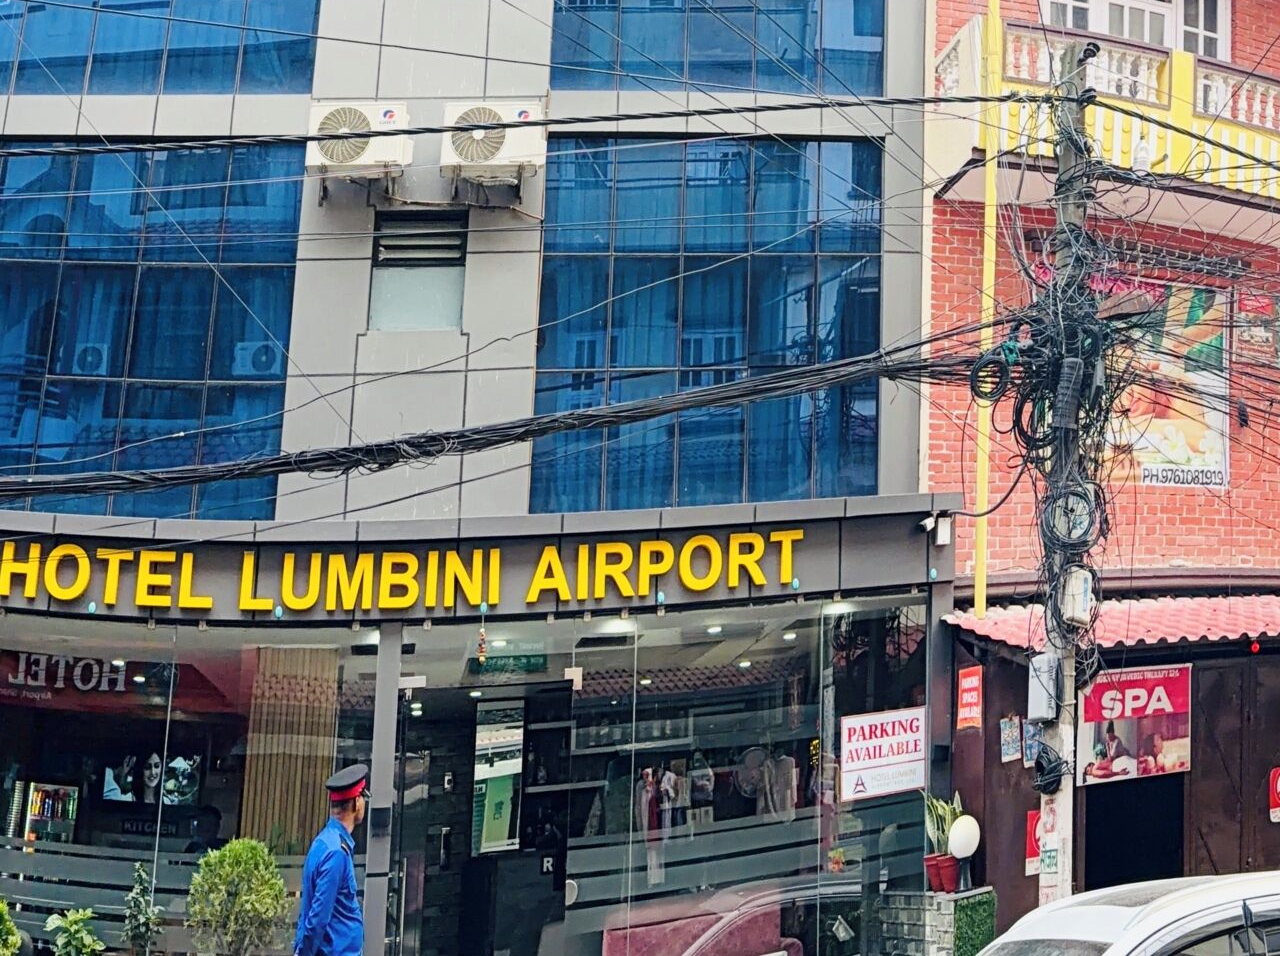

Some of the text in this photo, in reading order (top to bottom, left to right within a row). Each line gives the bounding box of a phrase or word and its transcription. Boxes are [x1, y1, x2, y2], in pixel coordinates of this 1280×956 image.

[239, 549, 501, 612] LUMBINI
[525, 529, 804, 604] AIRPORT
[1101, 686, 1174, 719] SPA
[846, 717, 920, 744] PARKING
[845, 738, 922, 764] AVAILABLE
